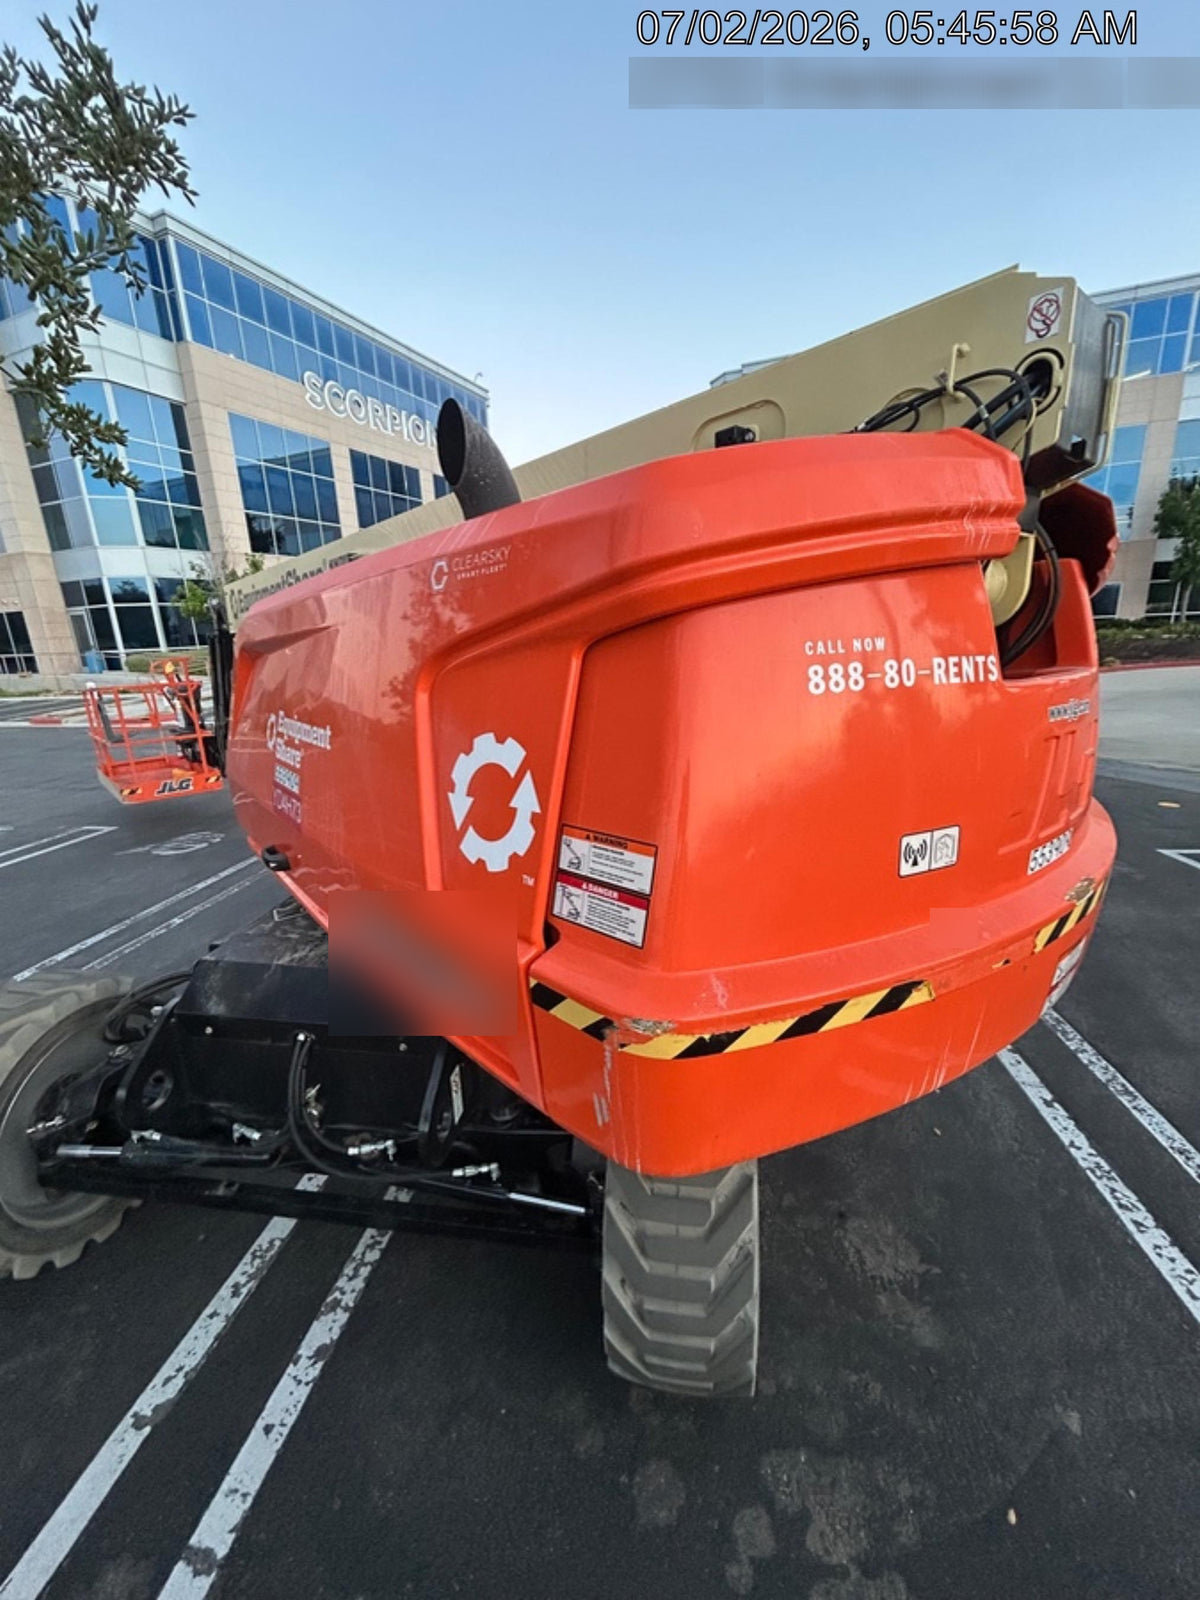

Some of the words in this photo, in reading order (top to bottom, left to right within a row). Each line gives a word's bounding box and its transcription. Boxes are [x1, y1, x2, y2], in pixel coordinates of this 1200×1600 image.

[452, 545, 512, 571] CLEARSKY
[804, 639, 845, 655] CALL
[853, 637, 886, 653] NOW
[807, 655, 999, 695] 888-80-RENTS
[278, 710, 331, 750] Equipment
[154, 777, 194, 797] JLG
[588, 882, 619, 900] DANGER
